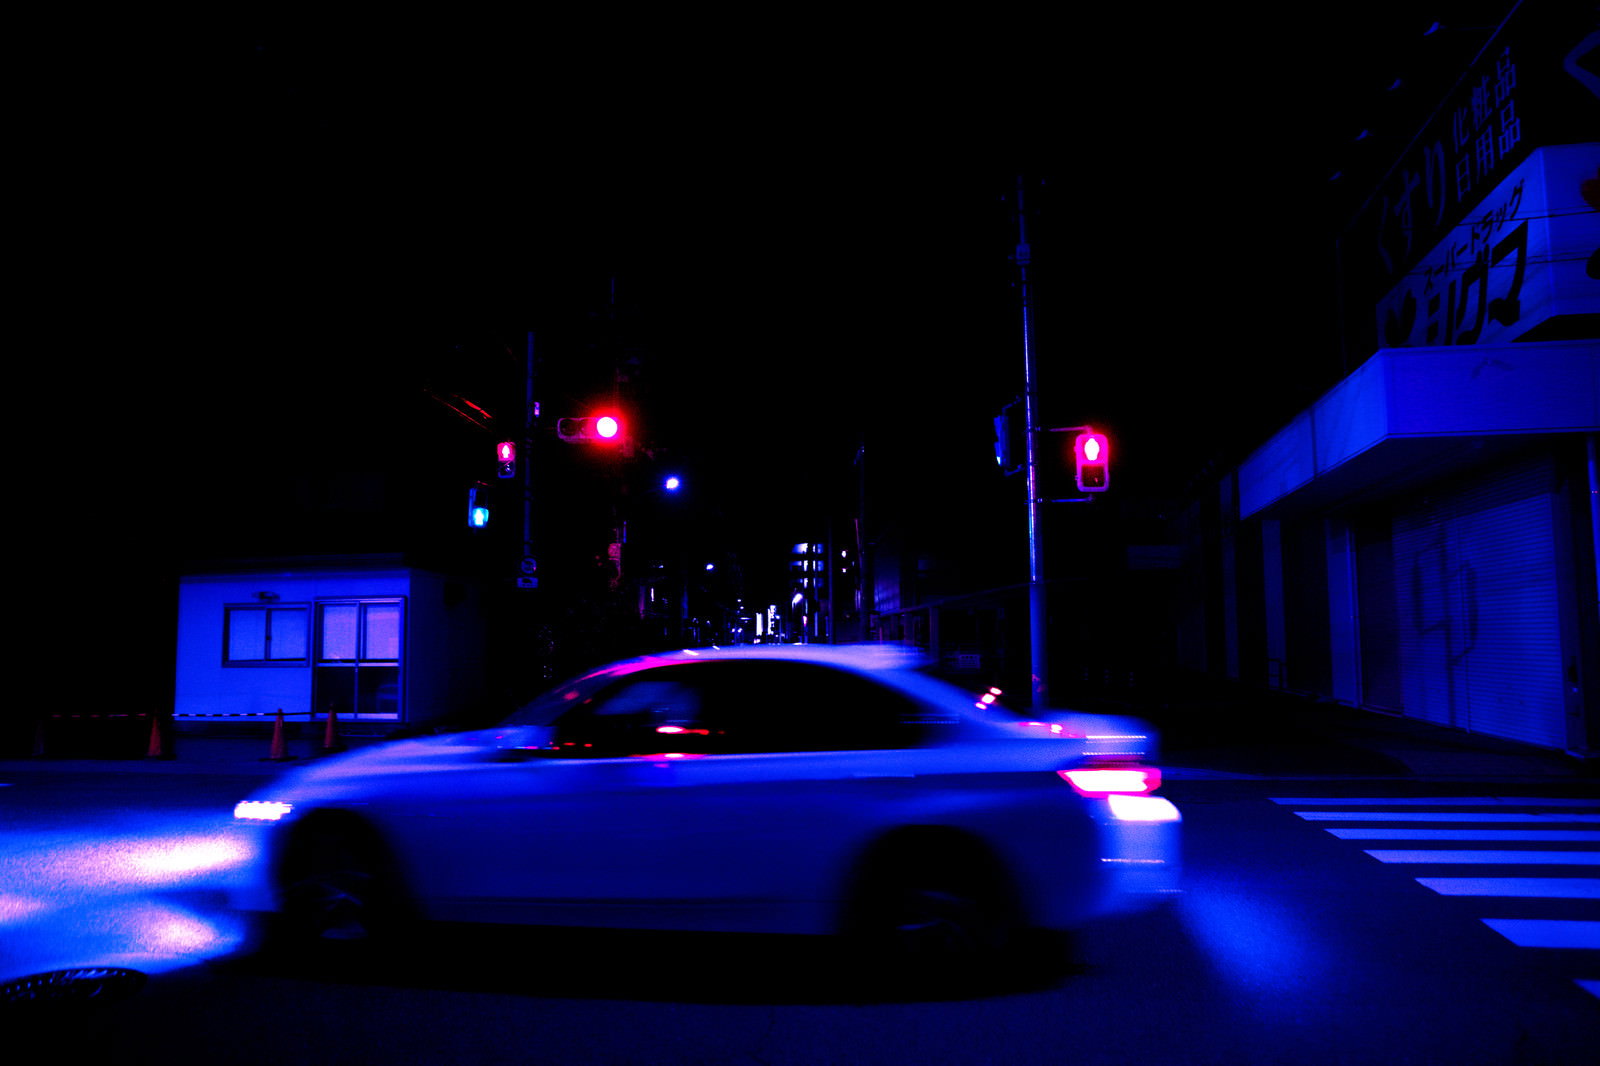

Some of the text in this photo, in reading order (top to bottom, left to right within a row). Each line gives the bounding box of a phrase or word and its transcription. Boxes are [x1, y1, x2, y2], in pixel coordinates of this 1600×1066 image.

[1376, 140, 1447, 275] くすり
[1455, 99, 1521, 203] 日用品
